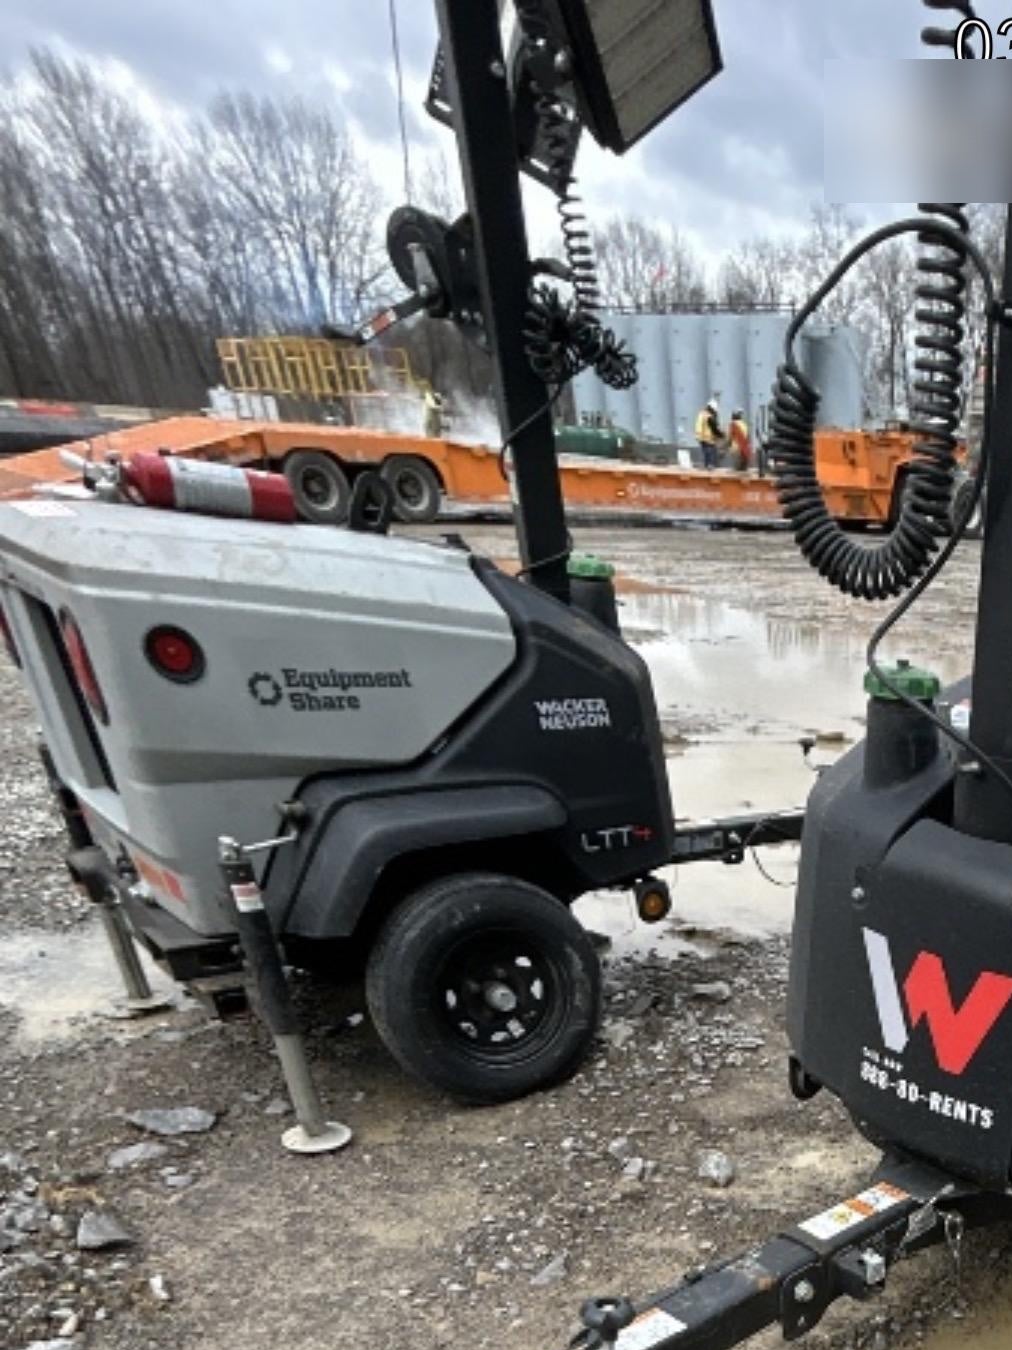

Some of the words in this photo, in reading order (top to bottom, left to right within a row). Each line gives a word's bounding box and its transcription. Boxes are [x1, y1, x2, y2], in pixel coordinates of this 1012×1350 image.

[281, 667, 413, 692] Equipment
[288, 692, 361, 712] Share
[533, 697, 608, 715] WACKER
[538, 713, 613, 731] NEUSON
